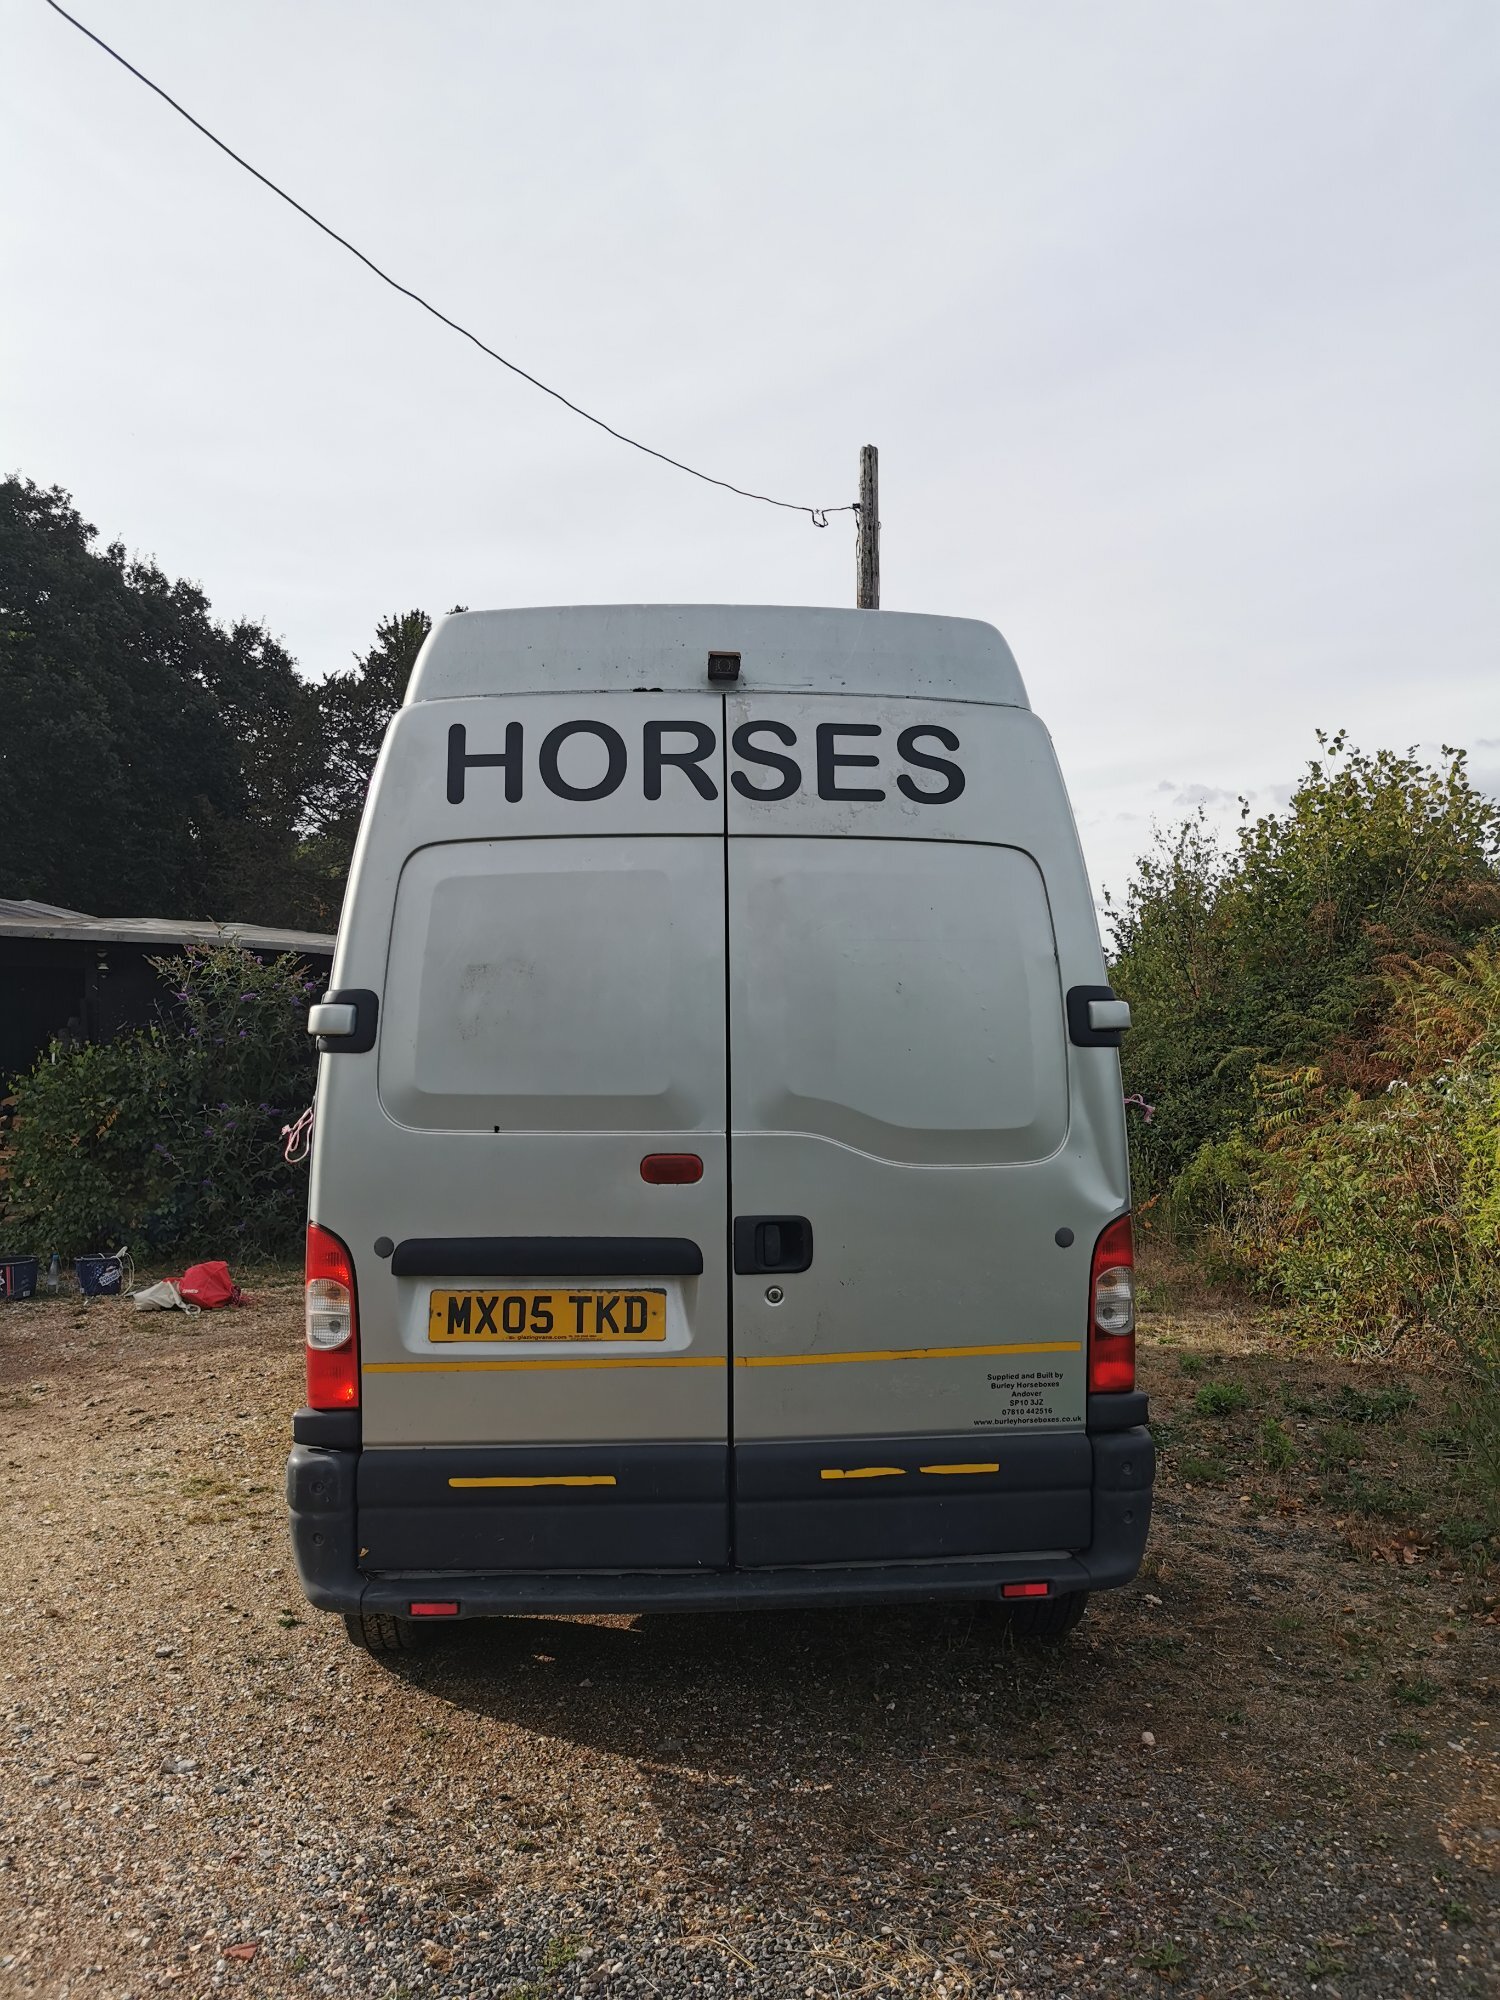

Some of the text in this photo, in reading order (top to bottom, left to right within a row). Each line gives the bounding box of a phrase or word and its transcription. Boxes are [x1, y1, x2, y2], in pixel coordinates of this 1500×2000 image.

[446, 719, 966, 806] HORSES
[447, 1295, 648, 1334] MX05 TKD
[987, 1373, 1019, 1381] Supplied
[1036, 1371, 1053, 1379] Built
[1054, 1371, 1064, 1380] by
[991, 1381, 1060, 1390] Burley Horseboxes
[973, 1415, 1082, 1426] www.burleyhorseboxes.co.uk
